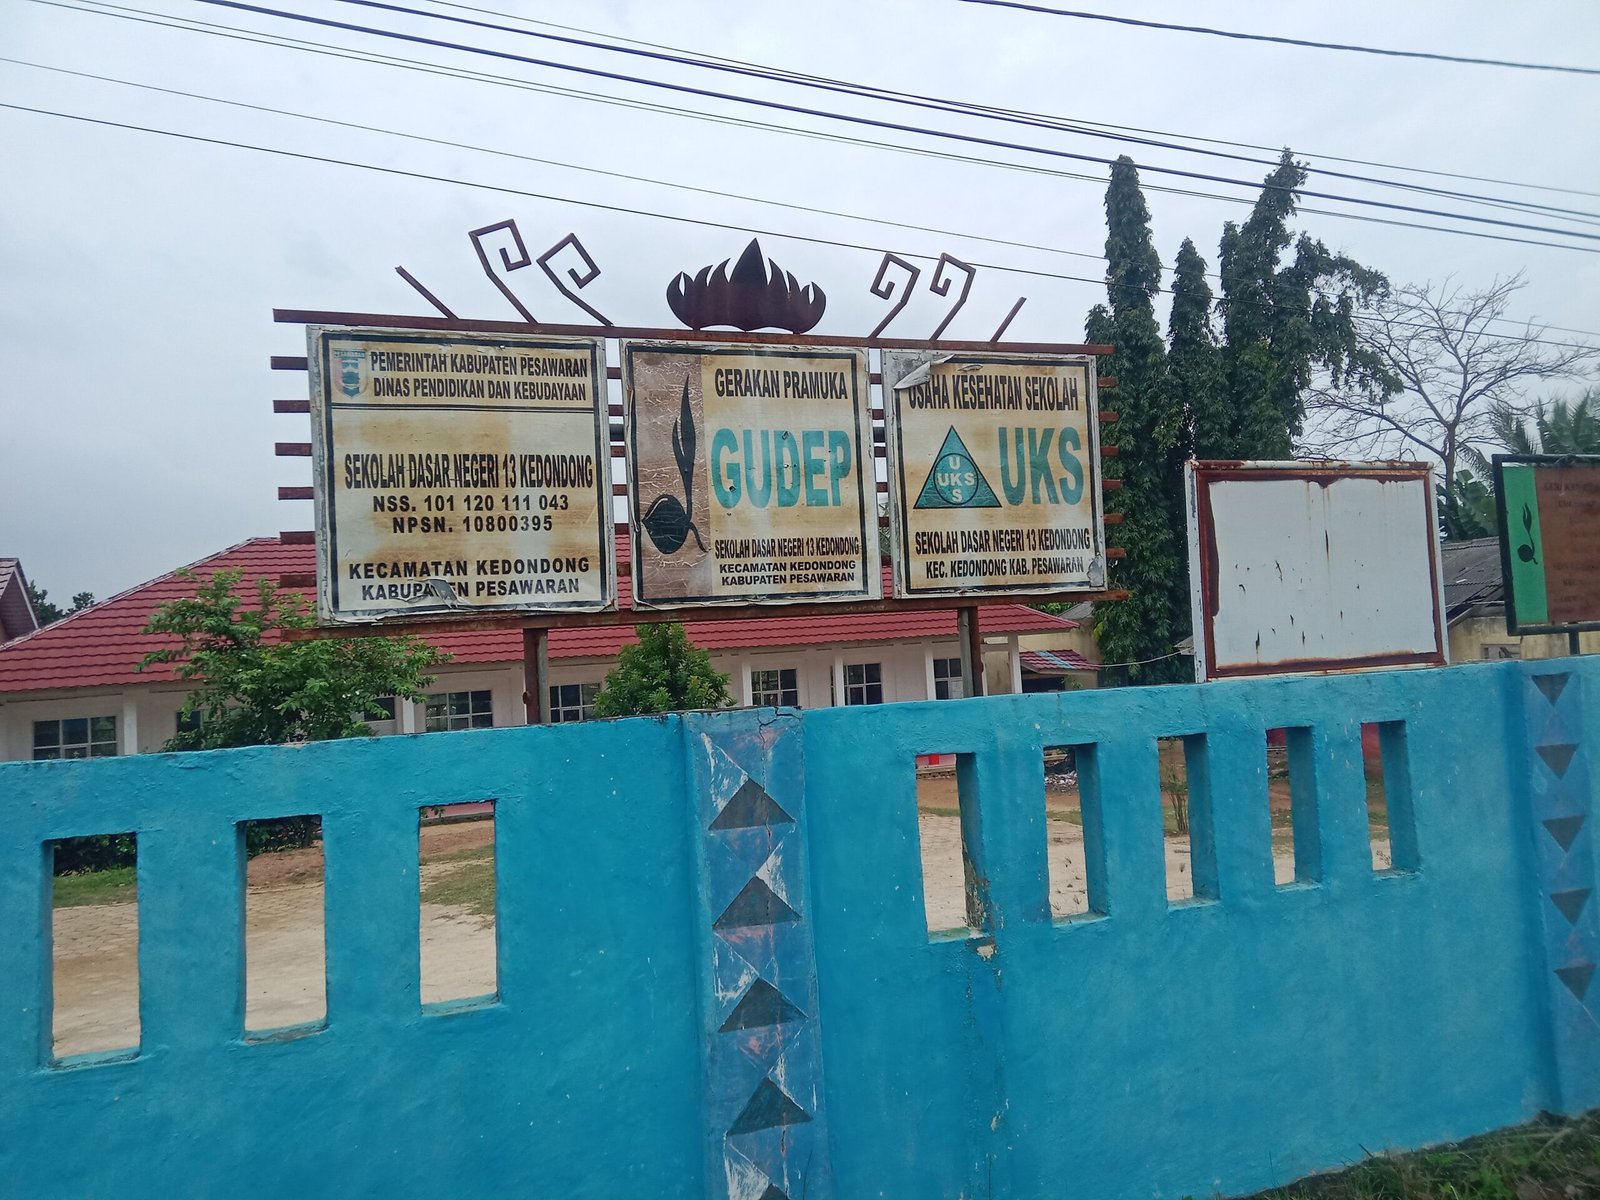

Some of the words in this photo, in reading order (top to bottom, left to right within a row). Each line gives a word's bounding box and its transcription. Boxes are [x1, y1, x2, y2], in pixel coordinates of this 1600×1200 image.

[371, 352, 447, 373] PEMERINTAH
[451, 354, 517, 375] KABUPATEN
[520, 357, 587, 377] PESAWARAN
[374, 378, 410, 397] DINAS
[414, 379, 484, 399] PENDIDIKAN
[488, 381, 511, 399] DAN
[514, 381, 586, 400] KEBUDAYAAN
[715, 369, 780, 398] GERAKAN
[784, 371, 848, 399] PRAMUKA
[909, 374, 949, 409] USAHA
[953, 375, 1022, 410] KESEHATAN
[1025, 378, 1079, 411] SEKOLAH
[345, 454, 404, 489] SEKOLAH
[408, 454, 450, 488] DASAR
[454, 454, 499, 488] NEGERI
[503, 455, 516, 488] 13
[520, 454, 593, 488] KEDONDONG
[711, 428, 851, 509] GUDEP
[949, 456, 960, 469] U
[998, 427, 1084, 506] UKS
[938, 473, 975, 486] UKS
[373, 496, 417, 512] NSS.
[424, 496, 454, 511] 101
[464, 495, 493, 511] 120
[502, 495, 530, 511] 111
[539, 494, 569, 510] 043
[952, 489, 962, 501] S
[393, 517, 453, 533] NPSN.
[463, 516, 553, 532] 10800395
[715, 540, 749, 559] SEKOLAH
[752, 539, 776, 558] DASAR
[778, 538, 804, 557] NEGERI
[806, 538, 814, 556] 13
[816, 537, 859, 556] KEDONDONG
[915, 531, 958, 555] SEKOLAH
[961, 531, 990, 553] DASAR
[993, 530, 1024, 552] NEGERI
[1027, 529, 1036, 551] 13
[1039, 528, 1090, 550] KEDONDONG
[349, 561, 468, 579] KECAMATAN
[477, 558, 589, 575] KEDONDONG
[720, 563, 787, 573] KECAMATAN
[790, 560, 856, 571] KEDONDONG
[926, 562, 948, 578] KEC.
[951, 560, 1007, 577] KEDONDONG
[1009, 559, 1029, 575] KAB.
[1032, 557, 1084, 574] PESAWARAN
[362, 580, 469, 600] KABUPAN
[476, 578, 579, 596] PESAWARAN
[722, 575, 787, 585] KABUPATEN
[790, 573, 854, 583] PESAWARAN
